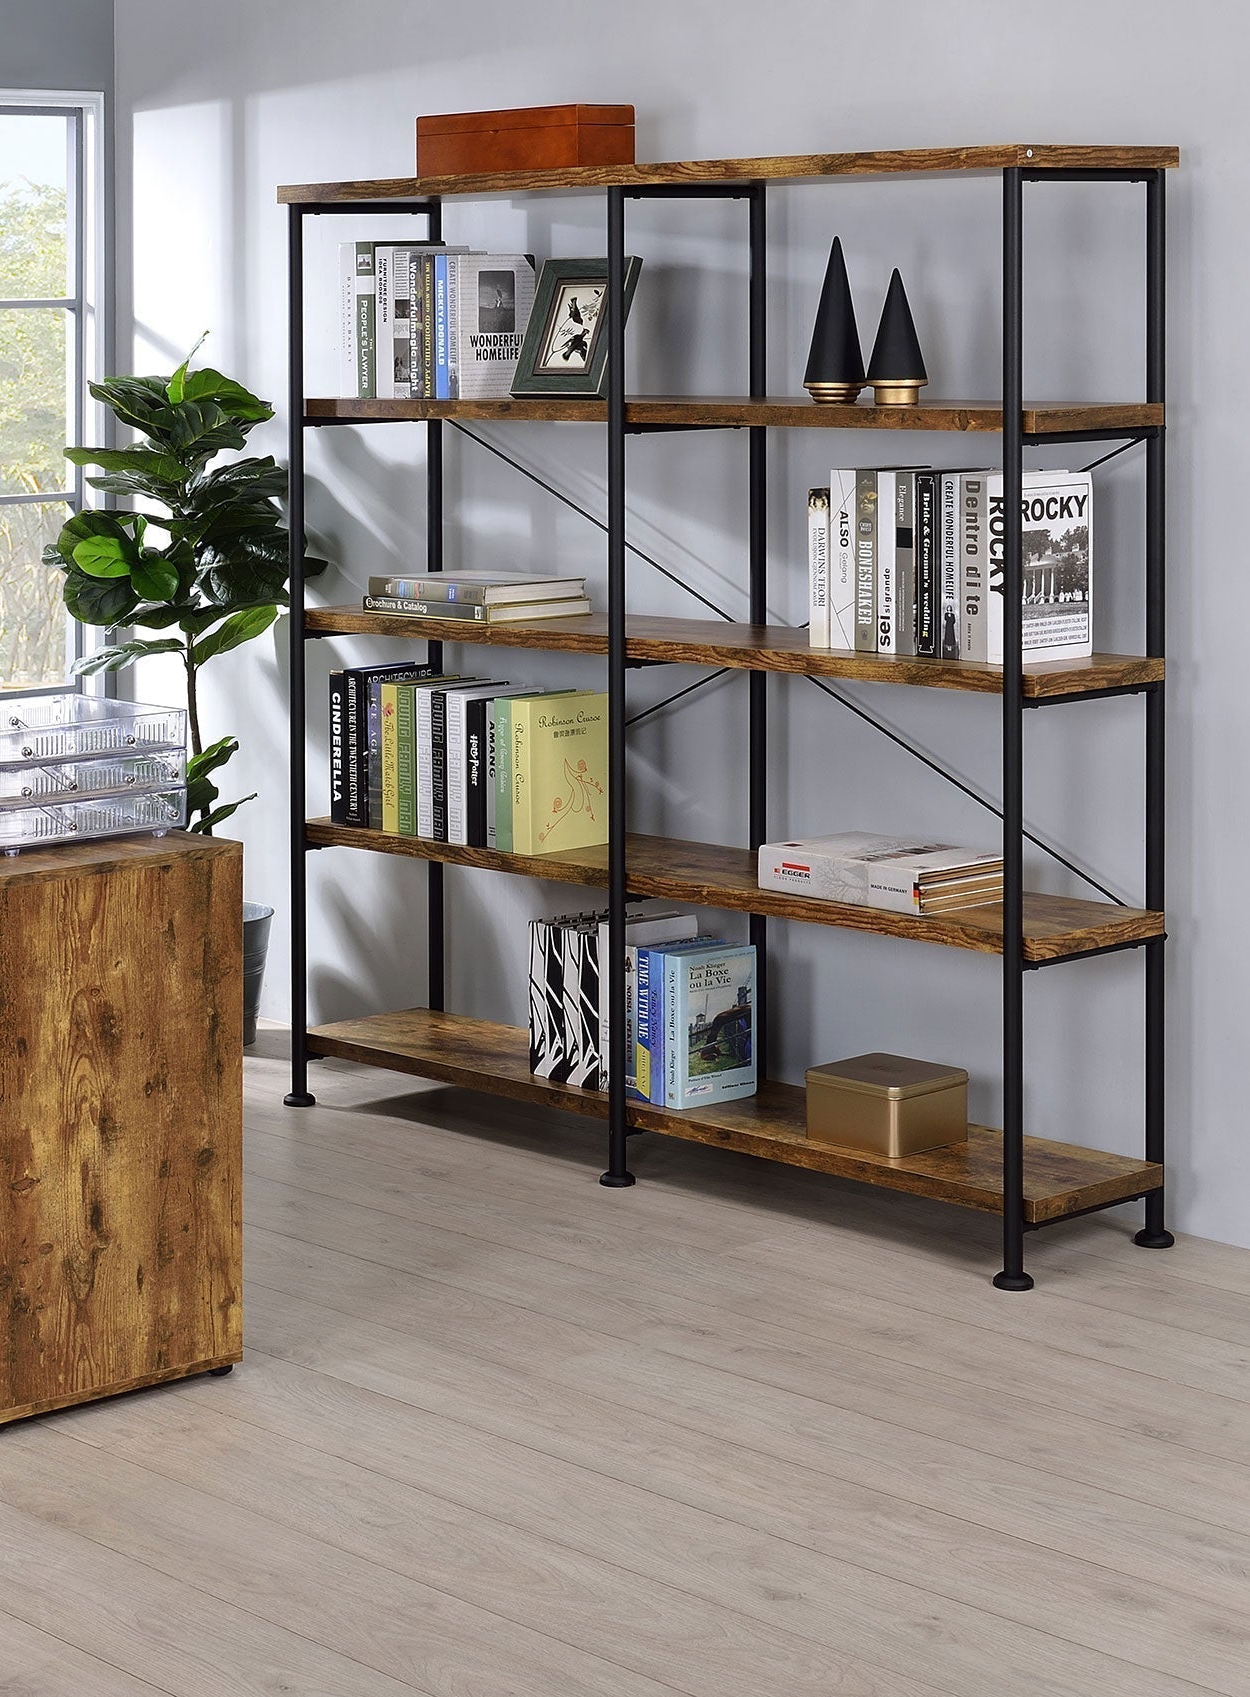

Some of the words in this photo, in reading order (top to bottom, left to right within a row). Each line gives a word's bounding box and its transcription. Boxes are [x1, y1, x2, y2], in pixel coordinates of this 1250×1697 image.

[360, 300, 368, 346] PEOPLE'S
[476, 348, 519, 361] HOMELIFE
[898, 485, 907, 522] Elegance
[923, 492, 931, 525] Bride
[944, 480, 954, 509] CREATE
[1021, 494, 1088, 522] ROCKY
[839, 511, 849, 548] ALSO
[923, 525, 931, 536] &
[965, 480, 981, 556] Dentro
[945, 511, 954, 559] WONDERFUL
[989, 496, 1004, 597] ROCKY
[817, 527, 826, 575] DARWINS
[818, 576, 826, 607] TEORI
[858, 541, 873, 625] BONESHAKER
[945, 561, 954, 600] HOMELIFE
[966, 566, 981, 587] di
[366, 597, 396, 610] Brochure
[397, 600, 402, 610] &
[403, 601, 427, 613] Catalog
[922, 592, 931, 638] wedding
[966, 595, 981, 616] te
[878, 615, 891, 647] sei
[384, 720, 395, 737] The
[538, 715, 575, 728] Robinson
[576, 710, 601, 724] Crusoe
[332, 692, 342, 802] CINDERELLA
[349, 733, 357, 746] THE
[384, 737, 395, 760] Little
[470, 733, 479, 760] Harry
[514, 722, 525, 769] Robinson
[349, 746, 357, 783] TWENTIETH
[399, 743, 411, 795] FAMILY
[433, 748, 444, 802] FAMILY
[469, 759, 479, 787] Potter
[350, 783, 358, 812] CENTURY
[384, 789, 395, 808] Girl
[515, 773, 525, 805] Crusoe
[400, 800, 412, 833] MAN
[433, 805, 444, 840] MAN
[782, 868, 811, 879] EGGER
[888, 886, 908, 894] GERMANY
[639, 956, 649, 986] TIME
[689, 964, 705, 972] Noah
[689, 981, 702, 989] ou
[704, 978, 714, 987] la
[715, 975, 732, 985] Vie
[690, 971, 703, 980] La
[705, 968, 729, 978] Boxe
[639, 988, 649, 1021] WITH
[639, 1021, 649, 1039] ME
[669, 1031, 675, 1041] La
